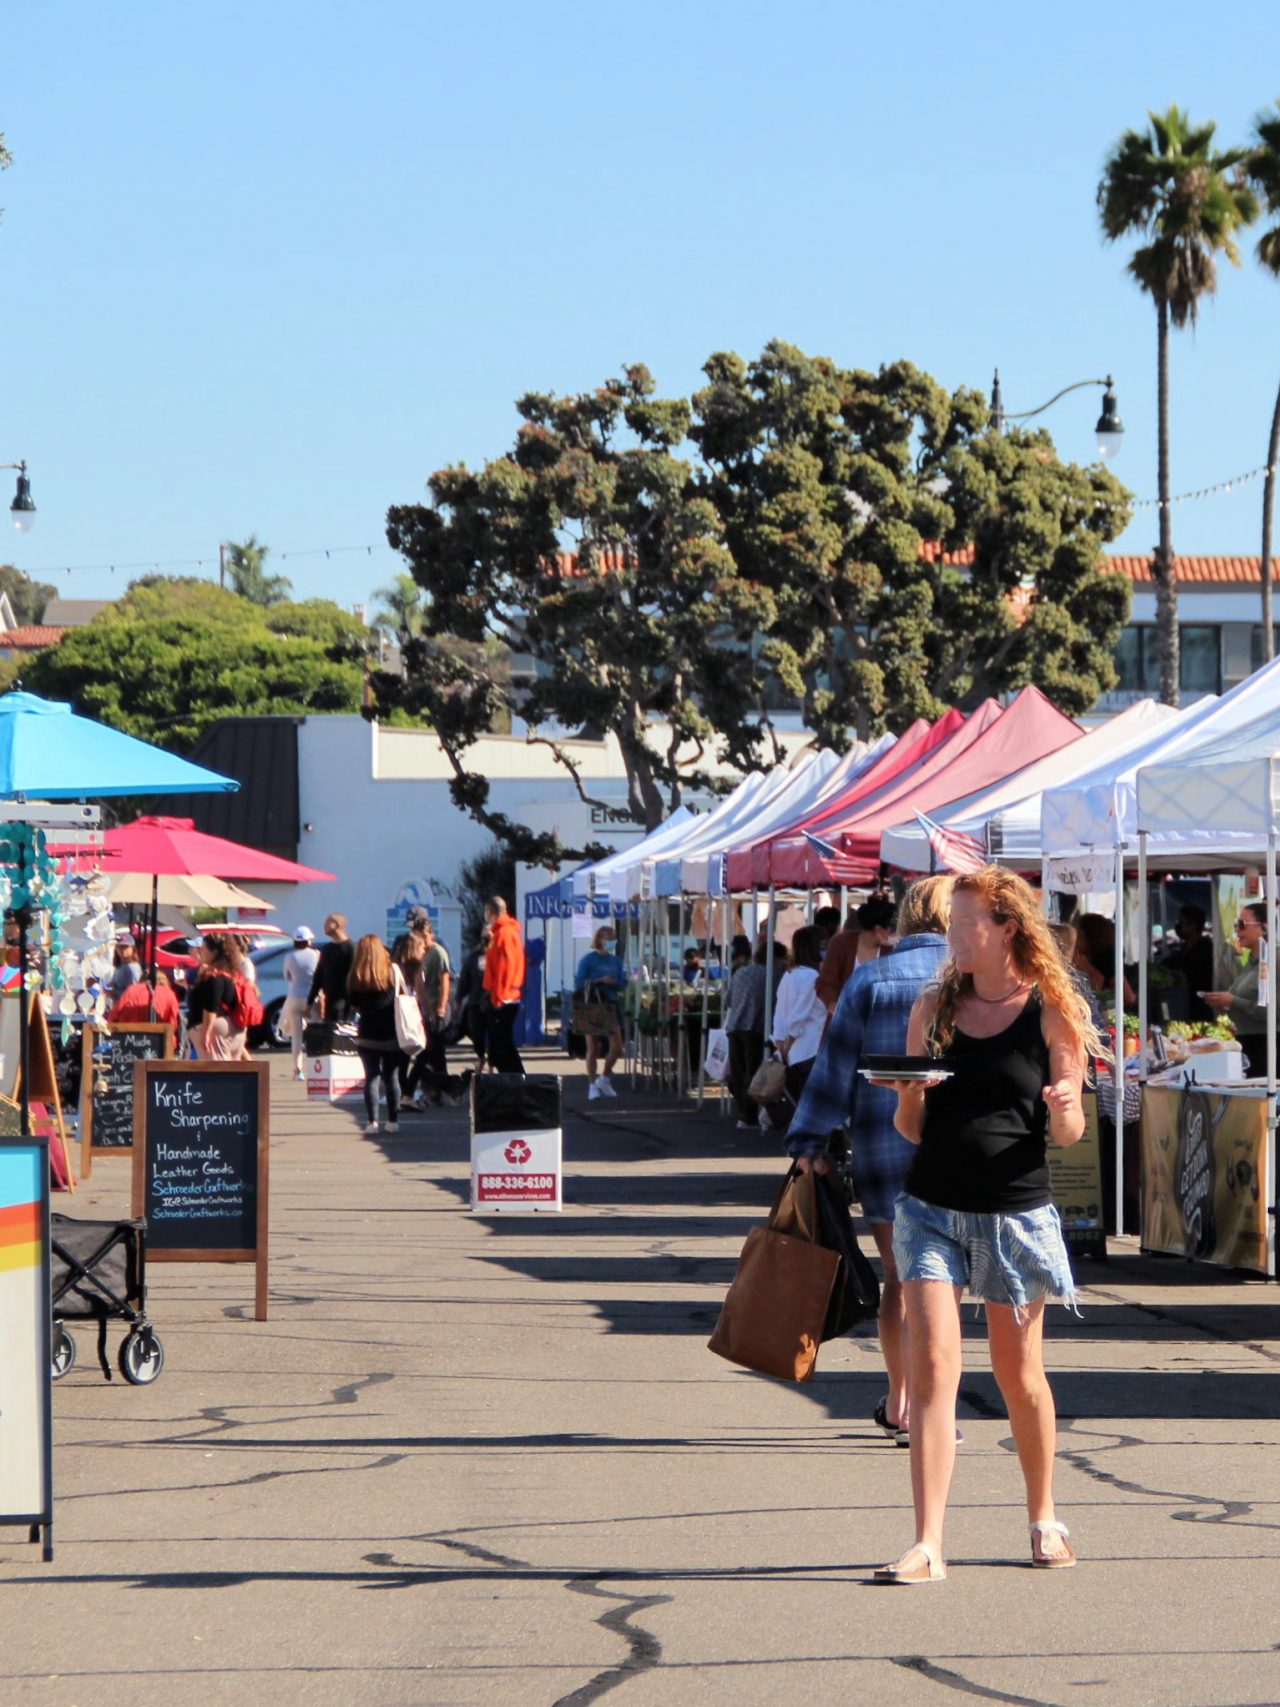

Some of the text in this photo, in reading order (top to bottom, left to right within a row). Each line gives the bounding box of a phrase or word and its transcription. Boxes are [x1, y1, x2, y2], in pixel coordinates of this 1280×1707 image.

[528, 895, 640, 915] INFOMATON
[125, 1035, 151, 1047] Made
[154, 1081, 203, 1107] Knife
[170, 1108, 249, 1135] Sharpening
[156, 1143, 221, 1161] Handmade
[153, 1161, 234, 1178] Leather Goods
[481, 1176, 553, 1189] 888-336-6100
